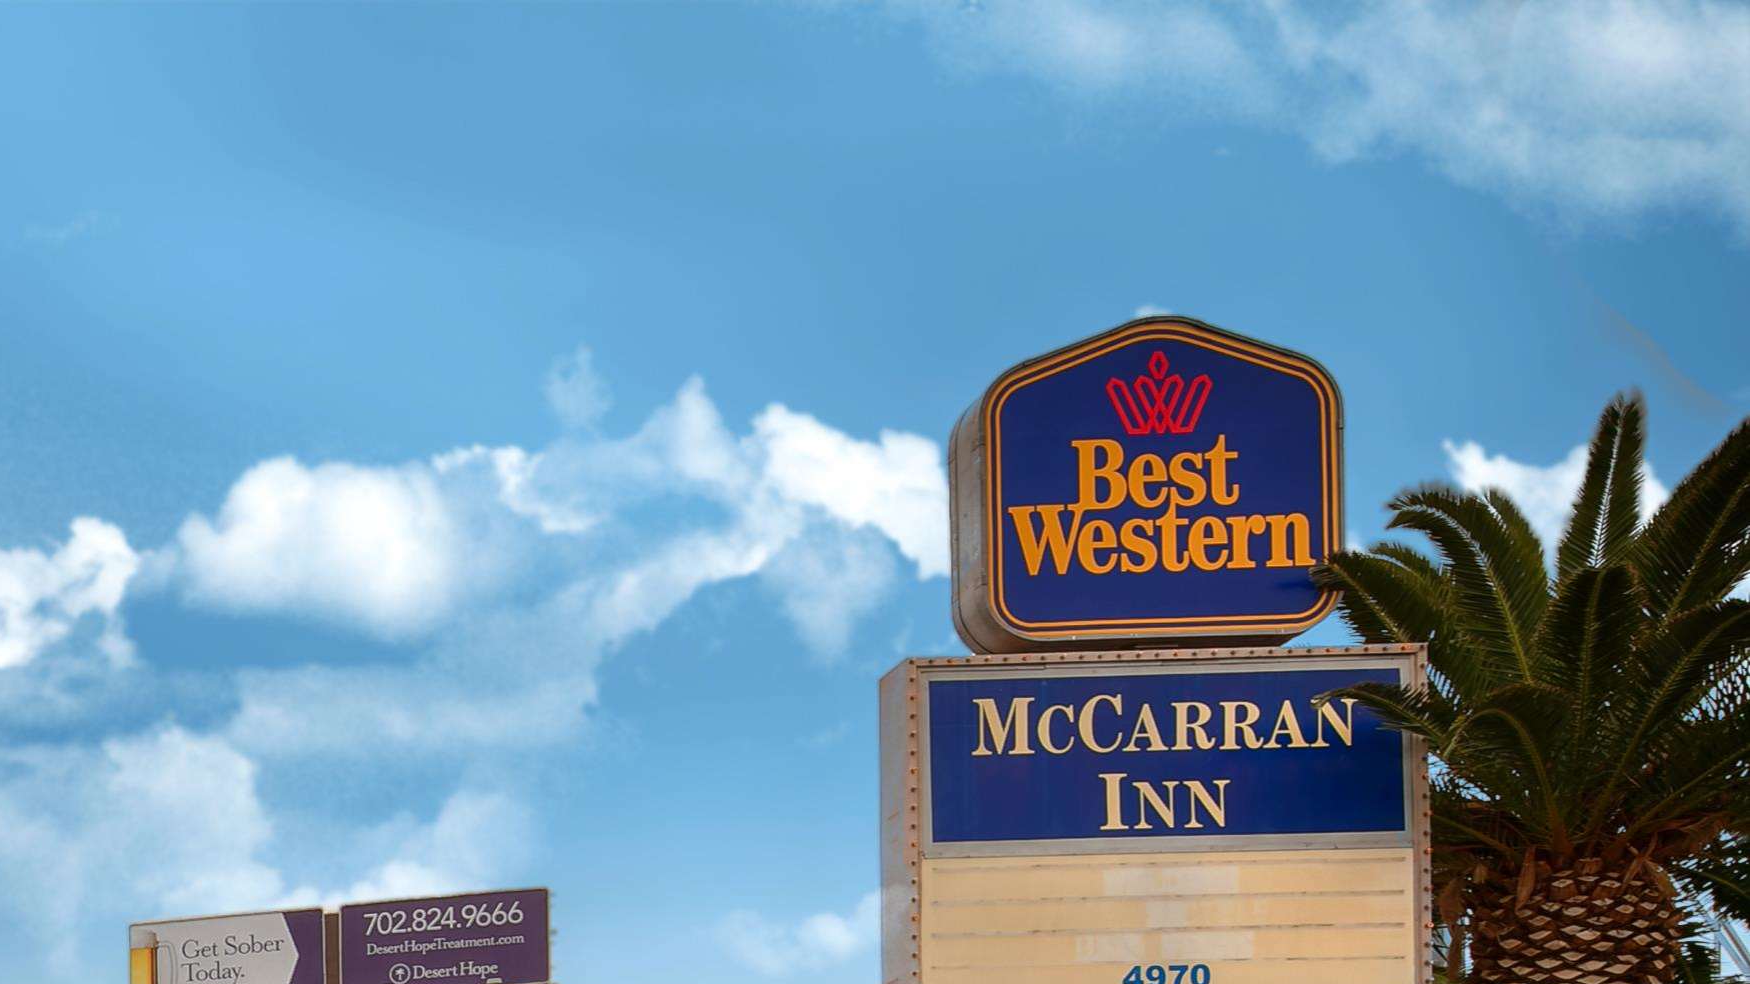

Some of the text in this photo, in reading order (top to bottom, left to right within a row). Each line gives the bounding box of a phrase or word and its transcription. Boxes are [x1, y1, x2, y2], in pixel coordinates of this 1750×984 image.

[1071, 433, 1240, 510] Best
[1008, 488, 1317, 576] Western
[1098, 773, 1230, 831] INN
[363, 901, 524, 936] 702.824.9666
[181, 934, 285, 959] Get Sober
[366, 935, 525, 955] DesertHopeTreatment.com
[413, 961, 499, 979] Desert Hope
